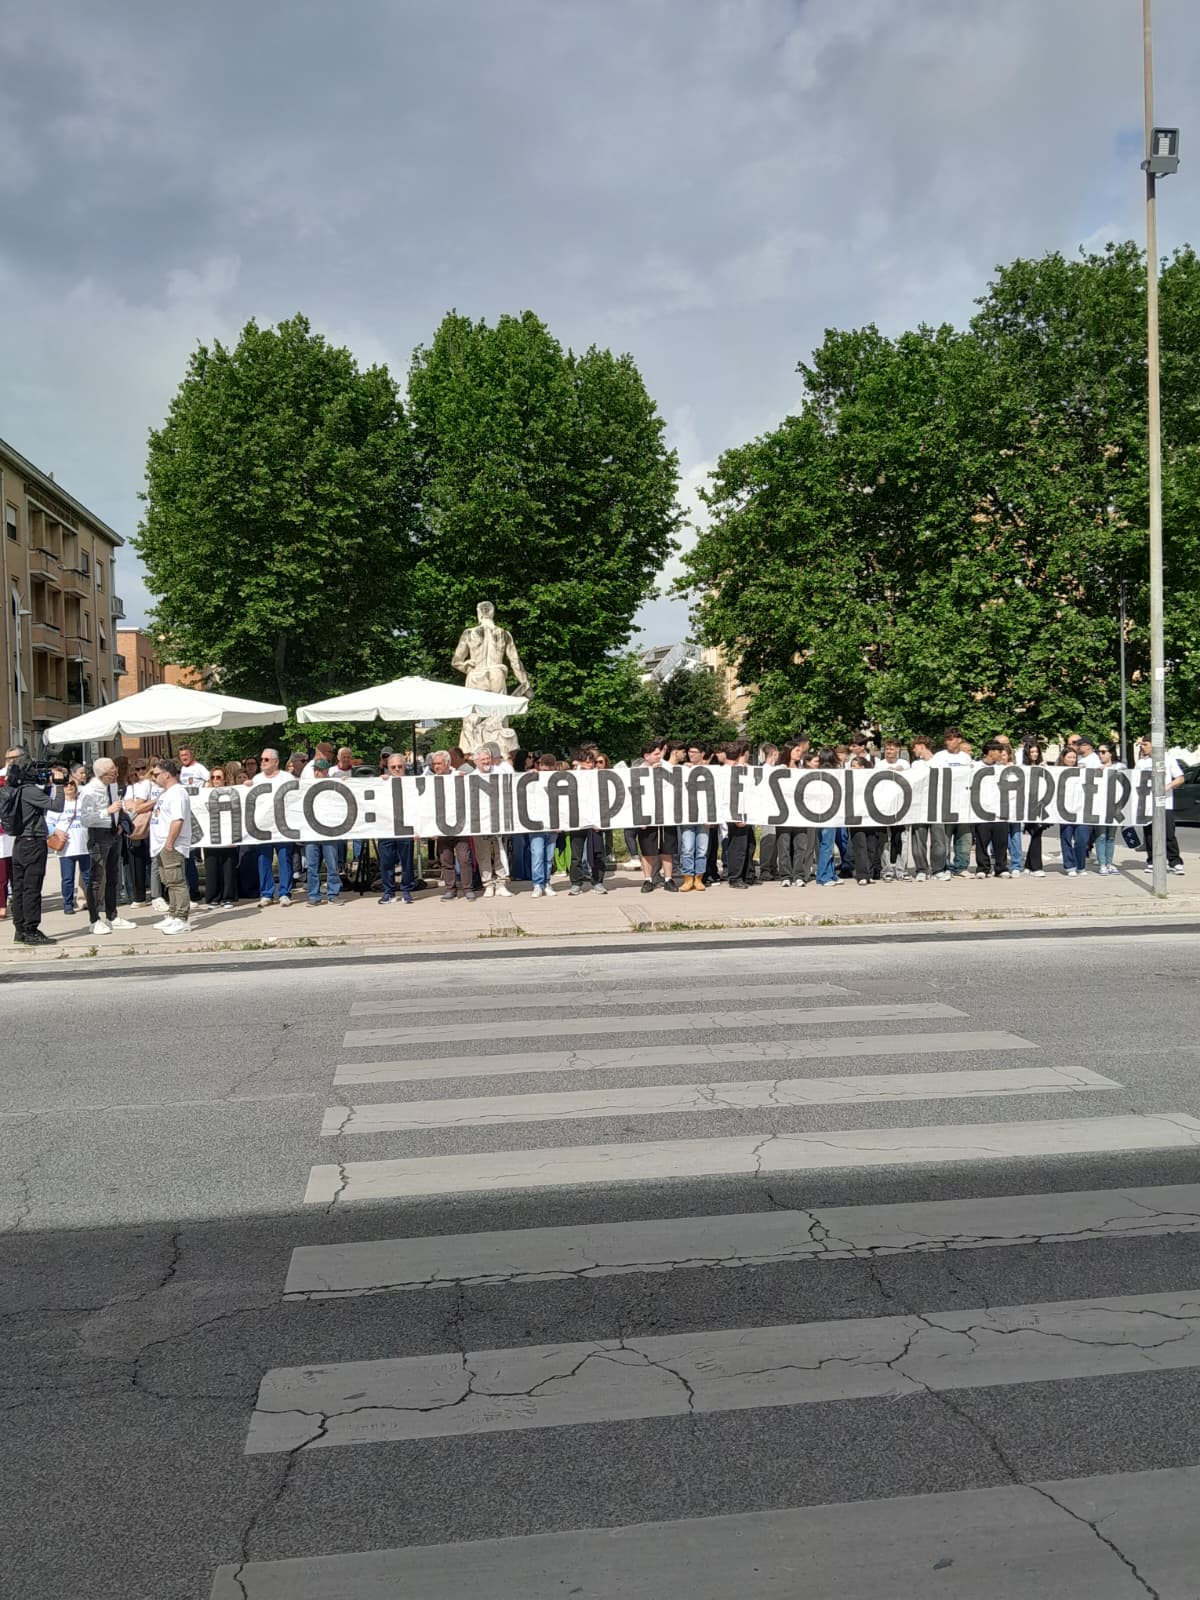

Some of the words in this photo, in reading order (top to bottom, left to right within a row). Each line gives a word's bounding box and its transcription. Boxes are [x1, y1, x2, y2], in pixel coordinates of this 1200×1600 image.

[392, 771, 579, 836] L'UNICA
[598, 765, 717, 828] PENA
[928, 767, 959, 822] IL
[970, 765, 1153, 824] CARCERE
